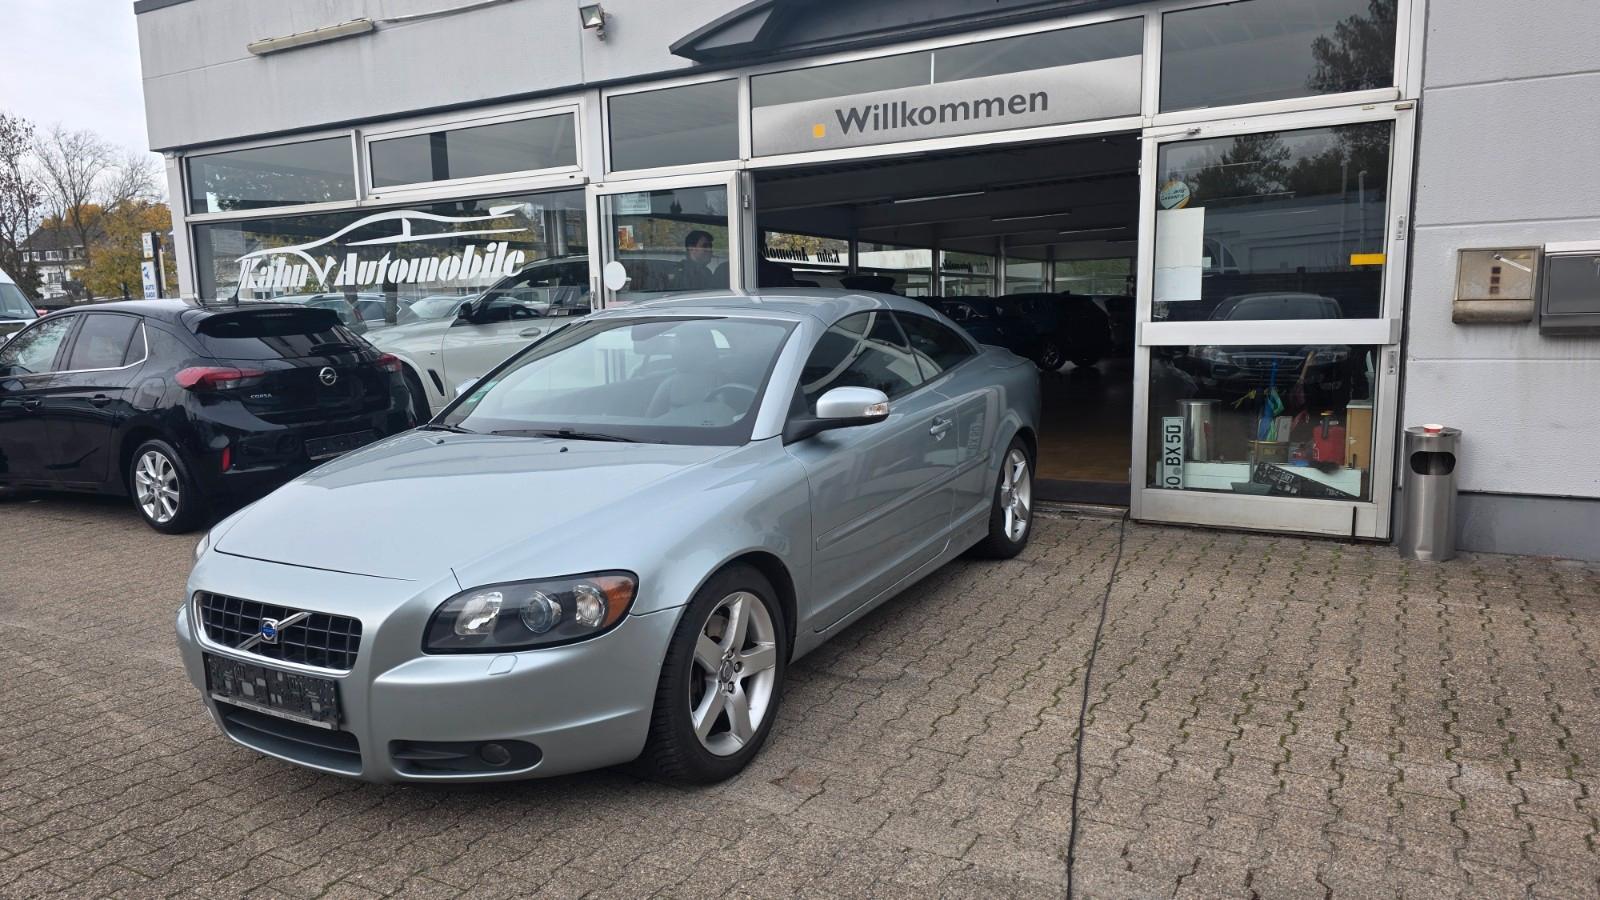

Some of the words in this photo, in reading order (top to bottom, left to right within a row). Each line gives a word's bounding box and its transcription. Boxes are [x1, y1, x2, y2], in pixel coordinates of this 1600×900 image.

[835, 90, 1048, 135] Willkommen
[239, 256, 309, 289] Kahn
[334, 241, 525, 287] Automobile
[1165, 424, 1181, 443] 50
[1165, 446, 1181, 466] BX
